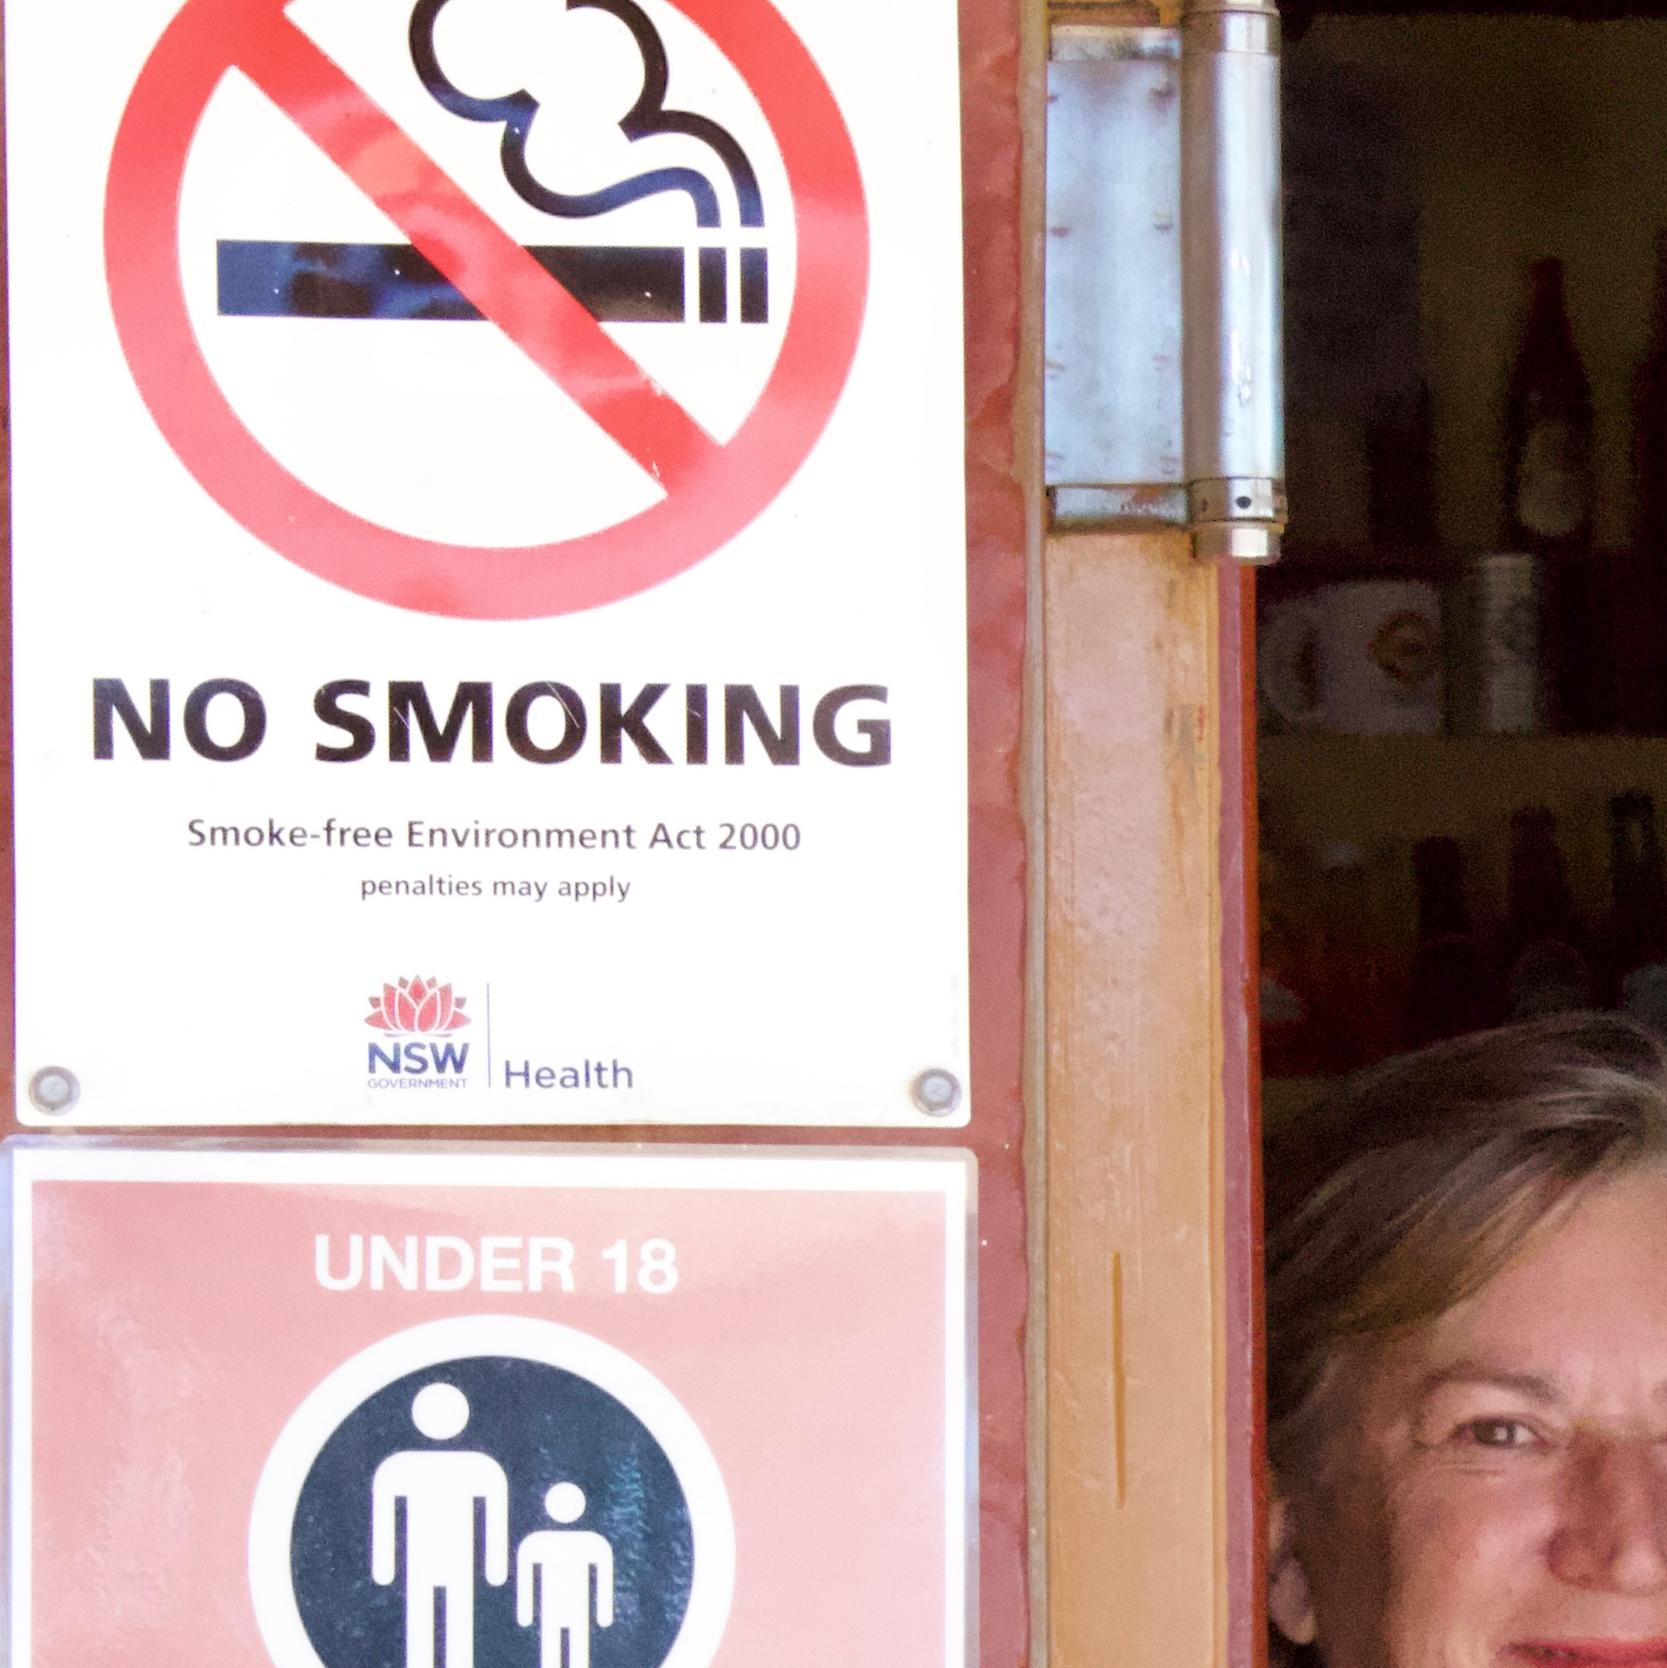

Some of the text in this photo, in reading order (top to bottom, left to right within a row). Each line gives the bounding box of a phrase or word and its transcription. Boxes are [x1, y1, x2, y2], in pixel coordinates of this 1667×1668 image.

[94, 679, 890, 766] NO SMOKING
[188, 818, 800, 850] Smoke-free Environment Act 2000
[361, 874, 630, 903] penalties may apply
[369, 1043, 468, 1074] NSW
[505, 1059, 632, 1088] Health
[367, 1078, 467, 1089] GOVERNMENT
[316, 1235, 678, 1293] UNDER 18
